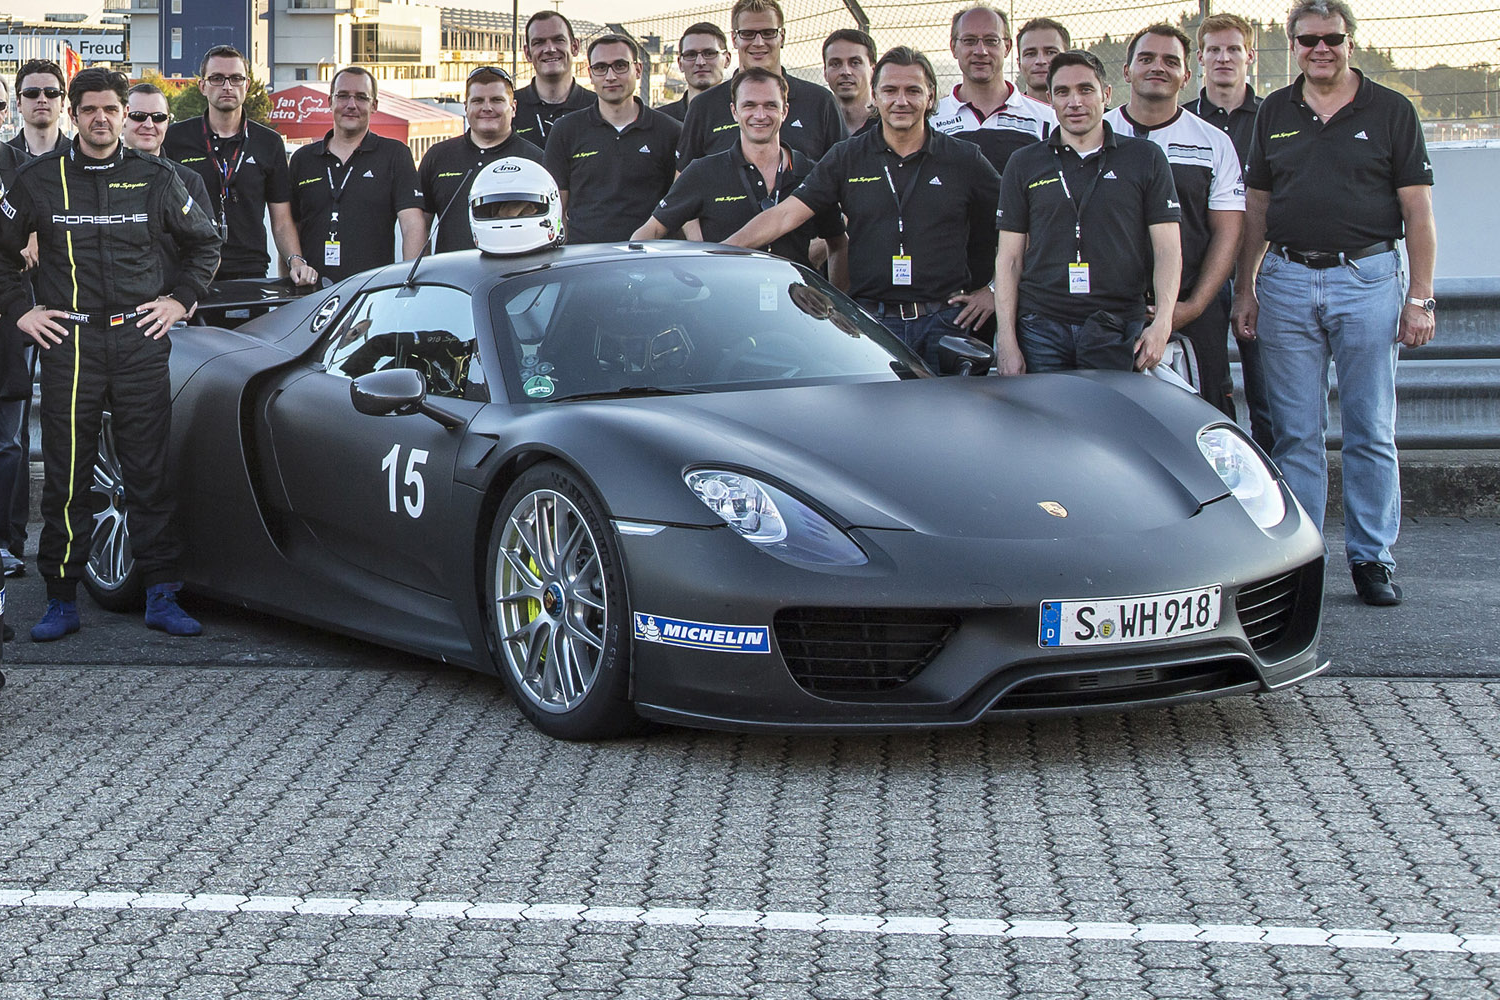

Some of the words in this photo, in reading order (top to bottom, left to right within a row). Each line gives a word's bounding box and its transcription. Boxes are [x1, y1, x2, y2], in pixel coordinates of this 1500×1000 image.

[276, 96, 296, 109] fan
[120, 181, 148, 190] Spyder
[52, 213, 148, 225] PORSCHE
[381, 443, 430, 519] 15
[1074, 606, 1096, 641] S
[1119, 602, 1159, 639] WH
[1164, 592, 1211, 633] 918
[663, 623, 764, 646] MICHELIN
[1046, 628, 1055, 639] D
